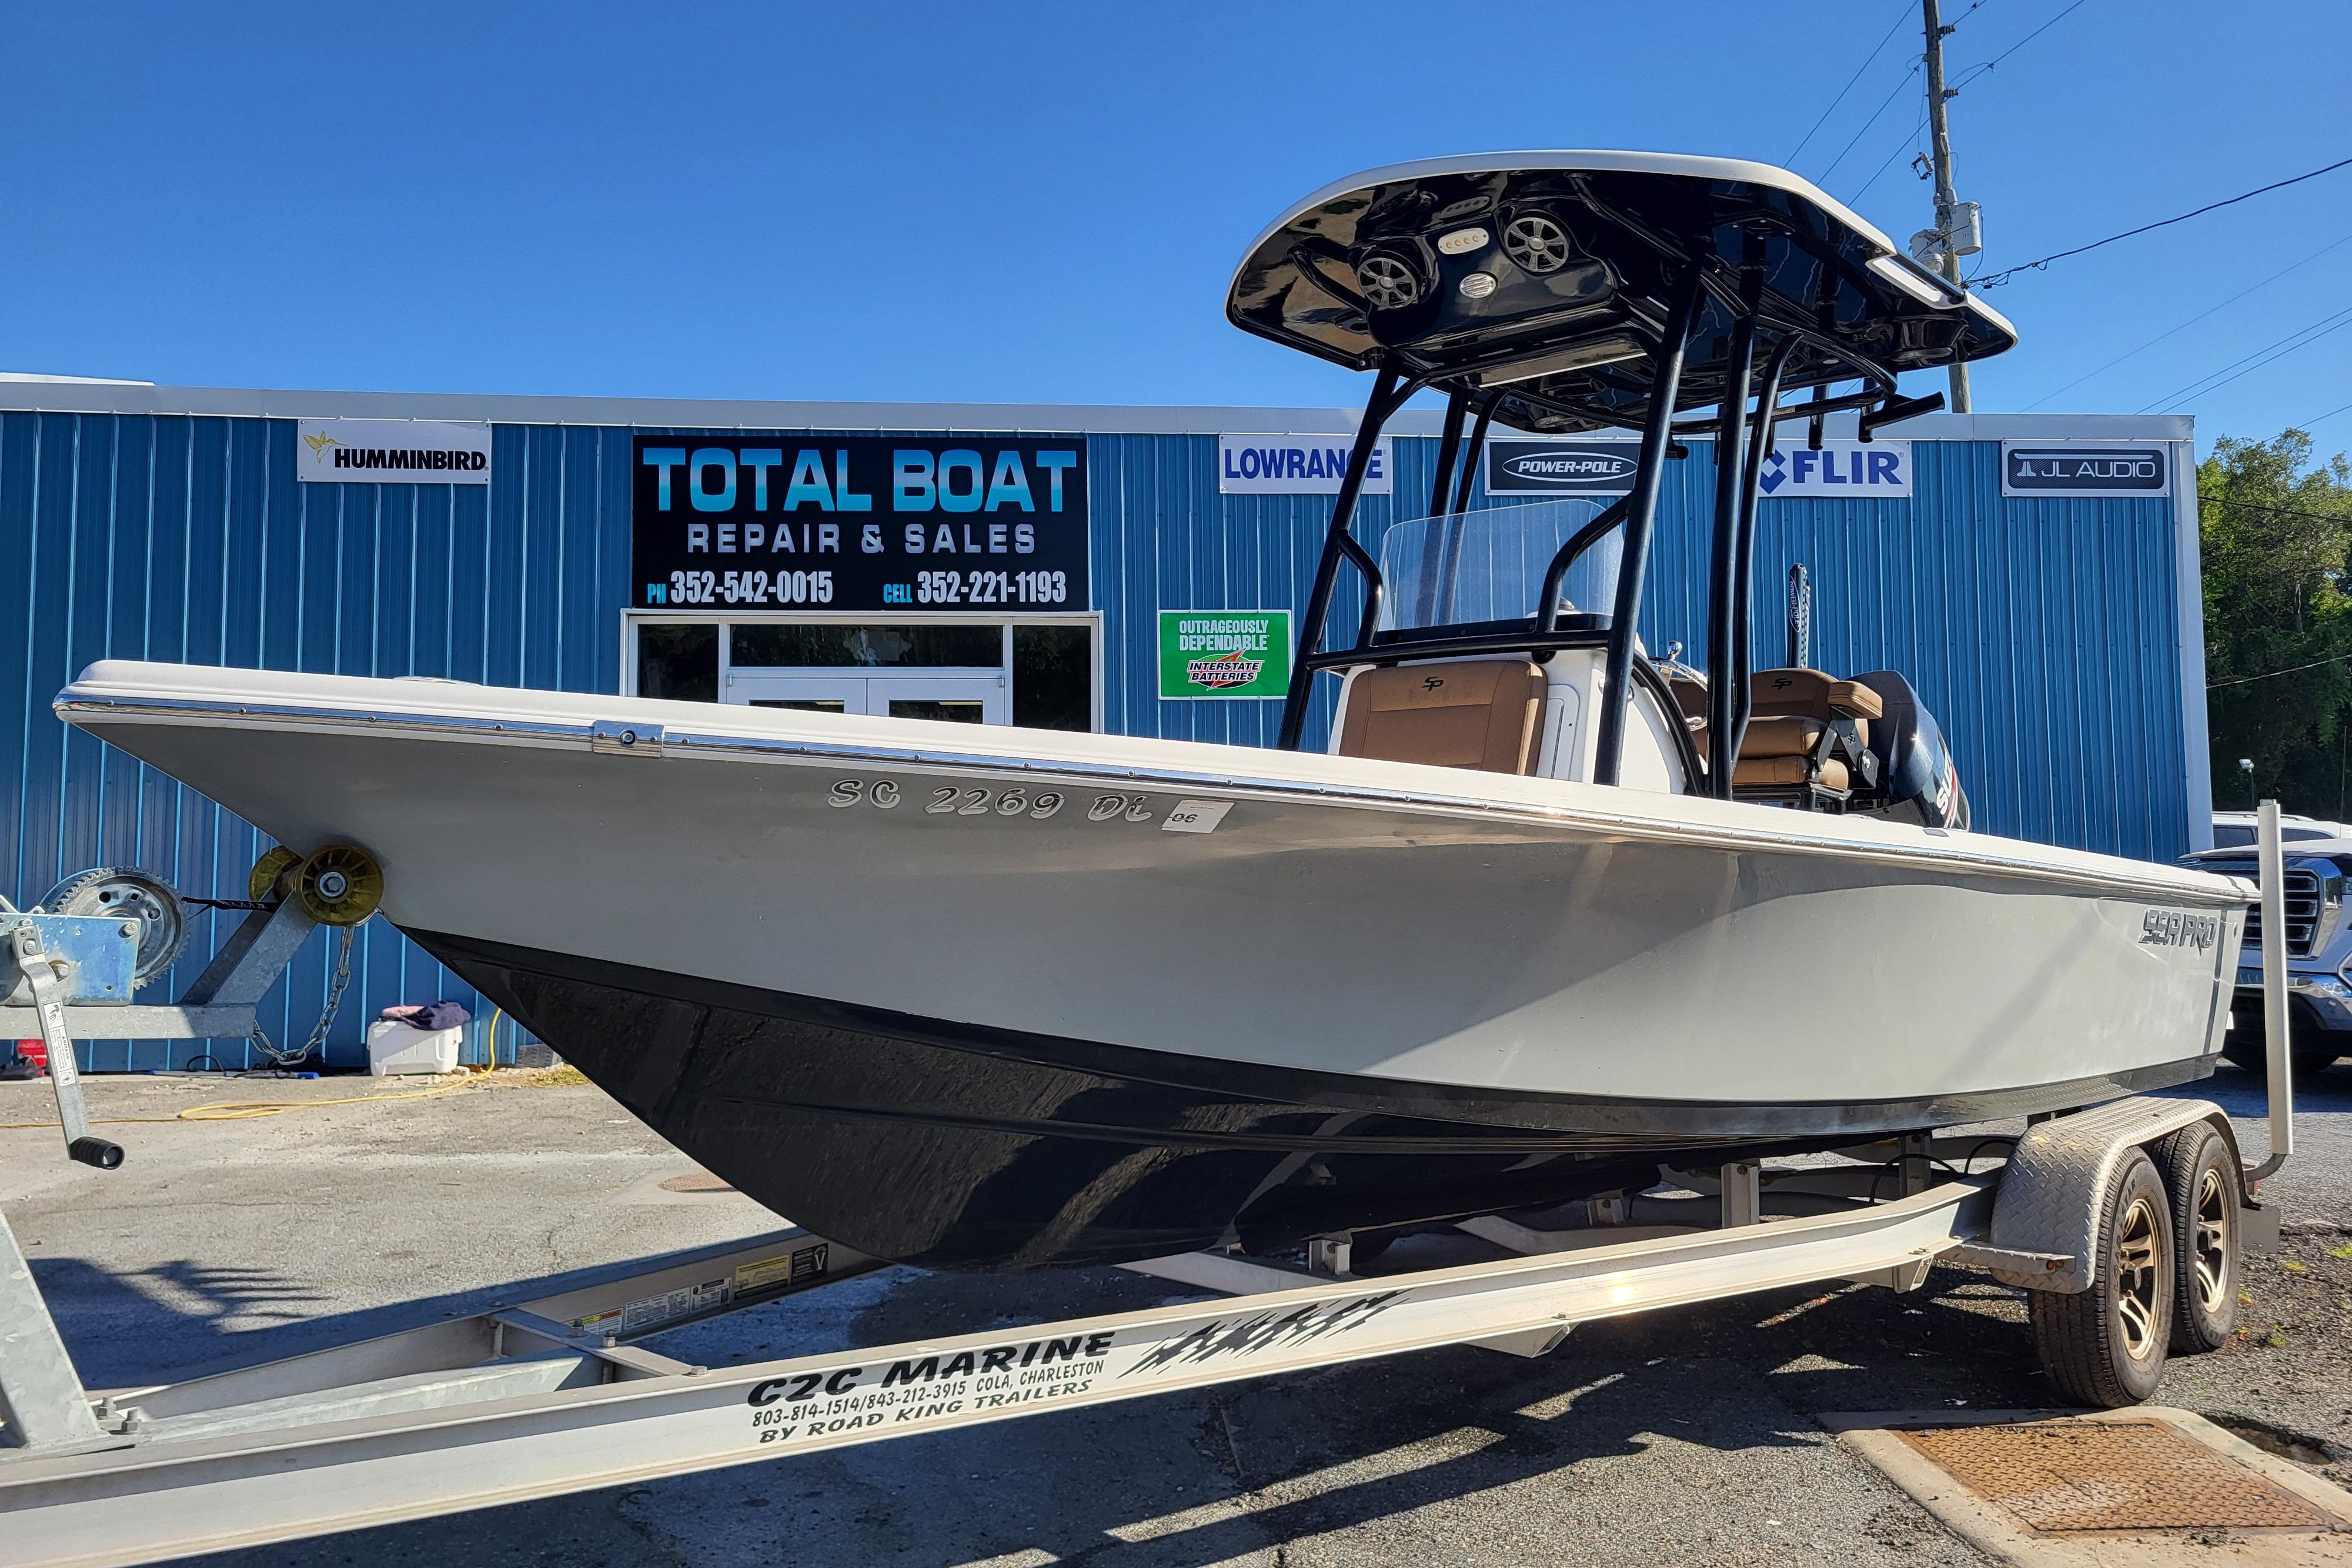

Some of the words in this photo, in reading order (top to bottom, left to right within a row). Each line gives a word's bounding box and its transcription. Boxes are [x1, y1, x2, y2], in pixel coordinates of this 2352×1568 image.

[335, 449, 487, 470] HUMMINBIRD
[1225, 448, 1383, 479] LOWRANE
[1518, 461, 1622, 473] POWER-POLE
[1793, 451, 1903, 484] FLIR
[2041, 461, 2070, 477] JL
[2076, 462, 2156, 477] AUDIO
[643, 448, 871, 511] TOTAL
[893, 449, 1077, 512] BOAT
[688, 523, 840, 553] REPAIR
[861, 524, 884, 553] &
[905, 523, 1035, 553] SALES
[647, 583, 666, 603] PH
[671, 570, 833, 603] 352-542-0015
[883, 583, 912, 603] CELL
[917, 571, 1066, 603] 352-221-1193
[1179, 620, 1269, 634] OUTRAGEOUSLY
[1180, 635, 1268, 651] DEPENDABLE
[1189, 662, 1259, 670] INTERSTATE
[1192, 672, 1254, 680] BATTERIES
[828, 779, 901, 809] SC
[924, 787, 1065, 819] 2269
[1171, 813, 1198, 823] 06
[2139, 910, 2181, 945] SEA
[2179, 914, 2218, 956] PRO
[748, 1368, 863, 1407] C2C
[880, 1331, 1115, 1388] MARINE
[752, 1380, 967, 1427] 803-814-1514/843-212-3915
[976, 1374, 1014, 1392] COLA,
[1020, 1359, 1105, 1386] CHARLESTON
[760, 1426, 798, 1443] BY
[807, 1413, 884, 1436] ROAD
[895, 1400, 963, 1422] KING
[974, 1379, 1093, 1409] TRAILERS
